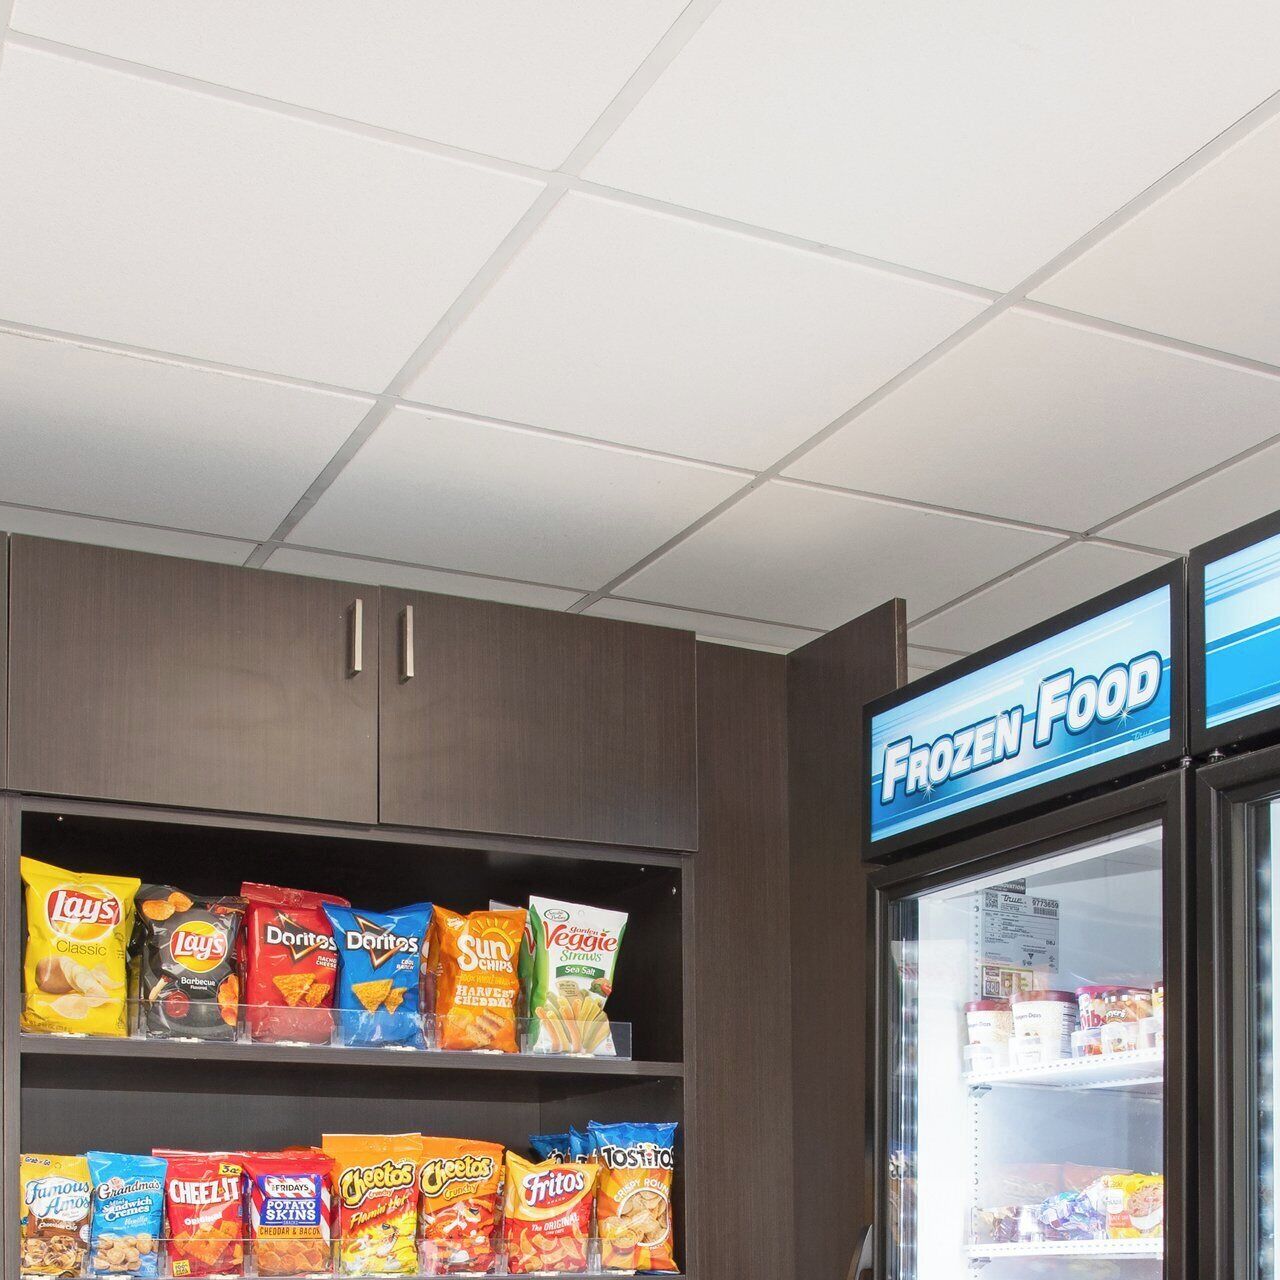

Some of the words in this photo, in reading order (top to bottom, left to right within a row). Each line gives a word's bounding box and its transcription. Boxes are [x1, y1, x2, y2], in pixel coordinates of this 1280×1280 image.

[881, 735, 1023, 805] FROZEN
[1033, 651, 1162, 749] FOOD
[51, 890, 120, 923] Lay's
[56, 940, 108, 956] Classic
[173, 931, 224, 960] Lay's
[266, 925, 337, 951] Doritos
[346, 931, 418, 952] Doritos
[542, 921, 619, 953] Veggie
[456, 934, 512, 972] Sun
[560, 950, 602, 962] Straws
[478, 960, 513, 973] CHIPS
[564, 966, 579, 974] Sea
[580, 966, 596, 976] Salt
[180, 976, 216, 986] Barbecue
[455, 985, 515, 998] HARVEST
[454, 996, 514, 1009] CHEDDAR
[340, 1163, 415, 1207] Cheetos
[420, 1156, 495, 1197] Cheetos
[522, 1170, 585, 1205] Fritos
[25, 1179, 90, 1205] Famous
[97, 1179, 161, 1201] Grandma's
[169, 1177, 239, 1205] CHEEZ-IT
[275, 1184, 309, 1192] FRIDAYS
[45, 1196, 90, 1218] Amos
[266, 1200, 315, 1211] POTATO
[266, 1209, 316, 1221] SKINS
